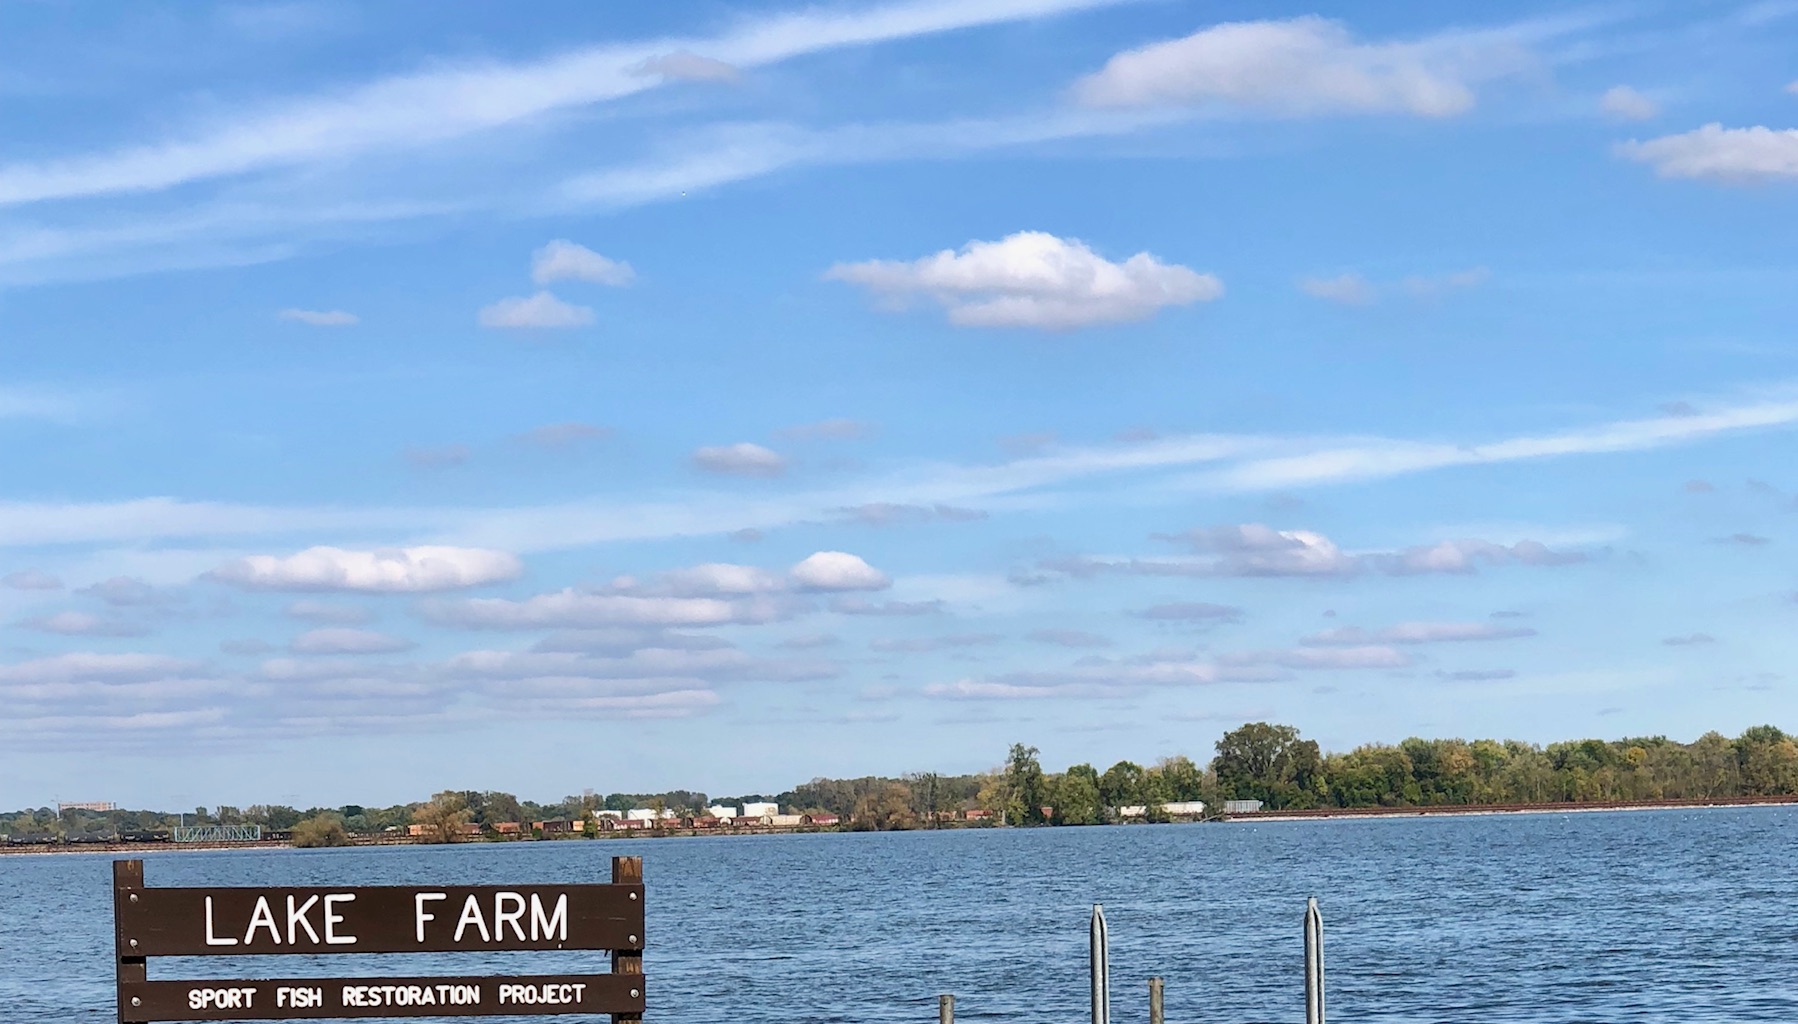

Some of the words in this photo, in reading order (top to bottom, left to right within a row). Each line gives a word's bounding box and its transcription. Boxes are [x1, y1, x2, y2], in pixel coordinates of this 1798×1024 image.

[205, 893, 357, 946] LAKE
[415, 892, 568, 943] FARM
[188, 987, 257, 1010] SPORT
[276, 986, 323, 1008] FISH
[342, 984, 480, 1007] RESTORATION
[499, 983, 587, 1005] PROJECT
